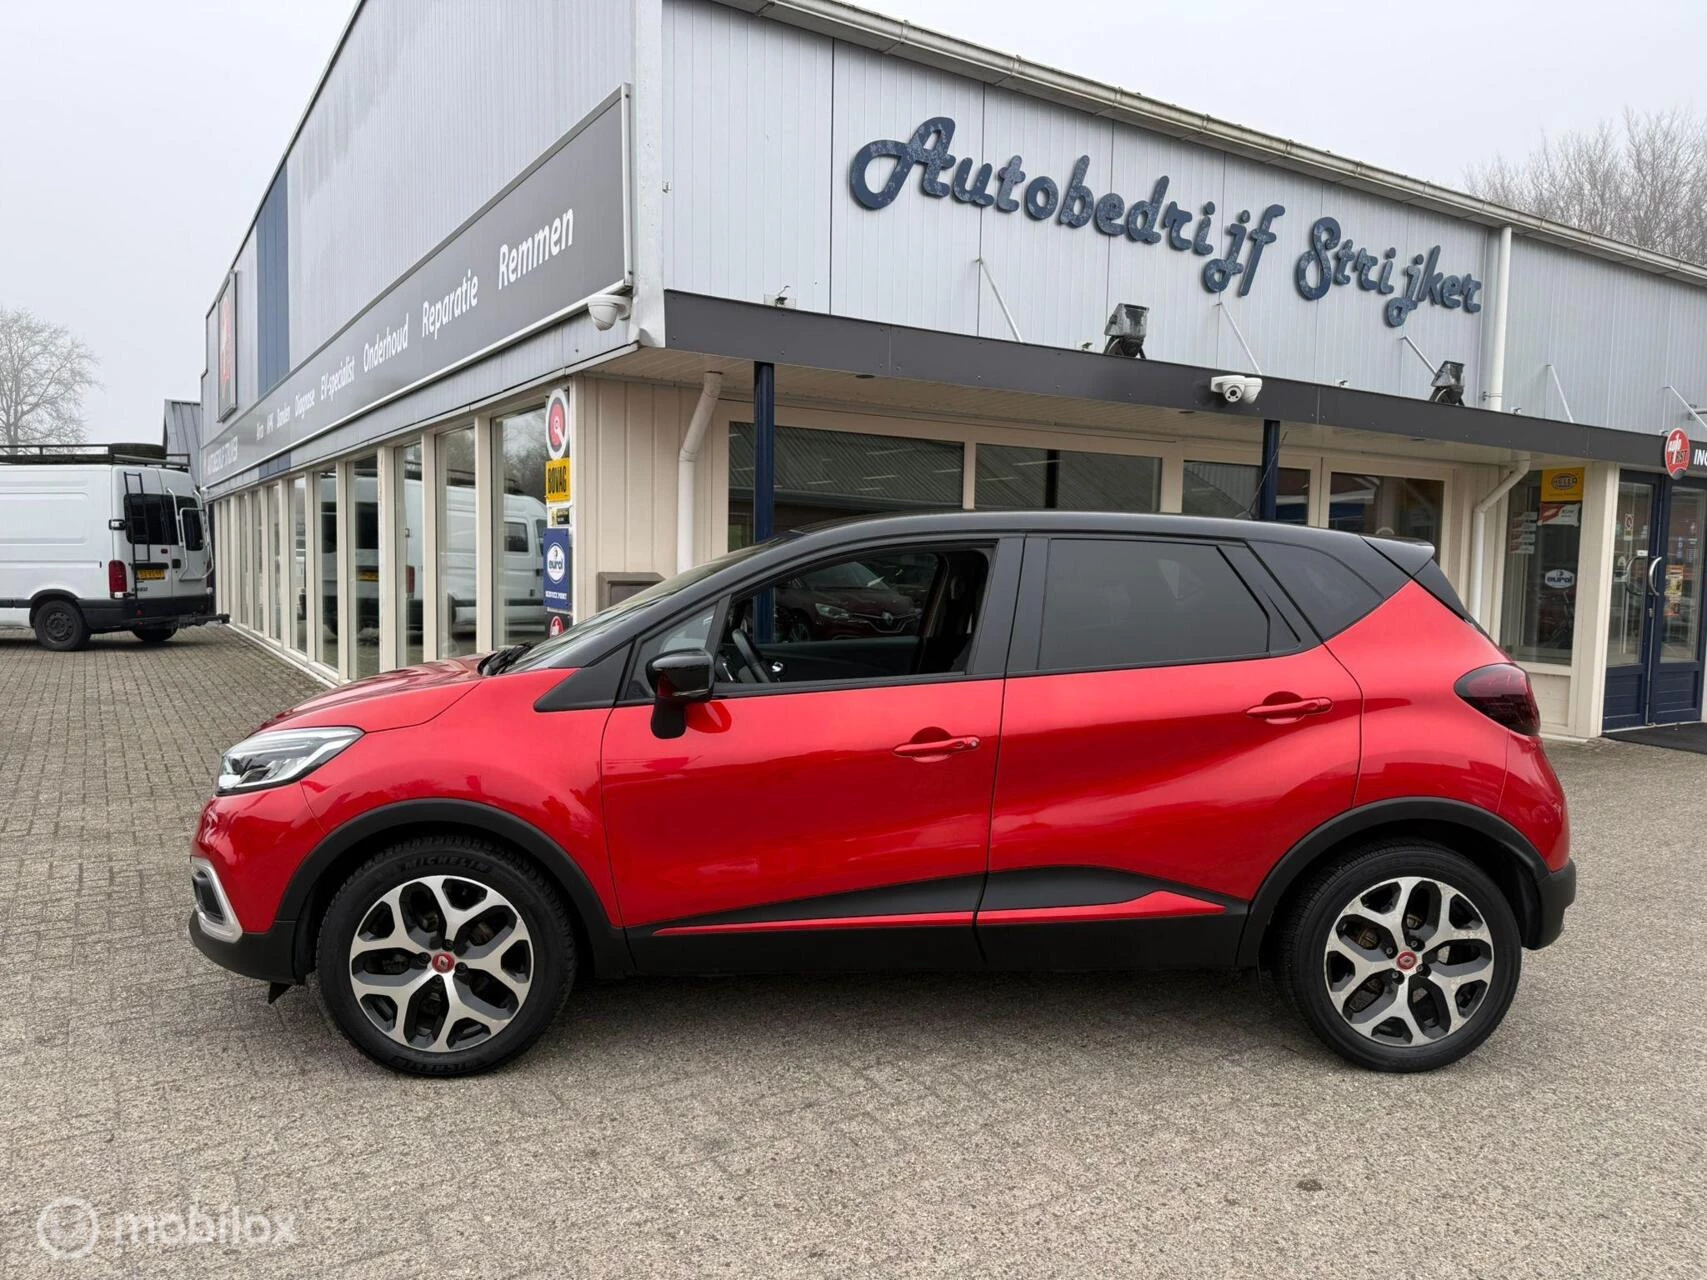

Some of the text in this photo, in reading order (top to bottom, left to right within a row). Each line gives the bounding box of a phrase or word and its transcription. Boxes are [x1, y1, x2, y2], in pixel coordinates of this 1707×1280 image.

[321, 355, 355, 401] EV-specialist
[363, 313, 409, 373] Onderhoud
[422, 268, 479, 341] Reparatie
[498, 208, 574, 290] Remmen
[850, 117, 1482, 328] Autobedrijf Strijker
[547, 466, 567, 494] BOVAG
